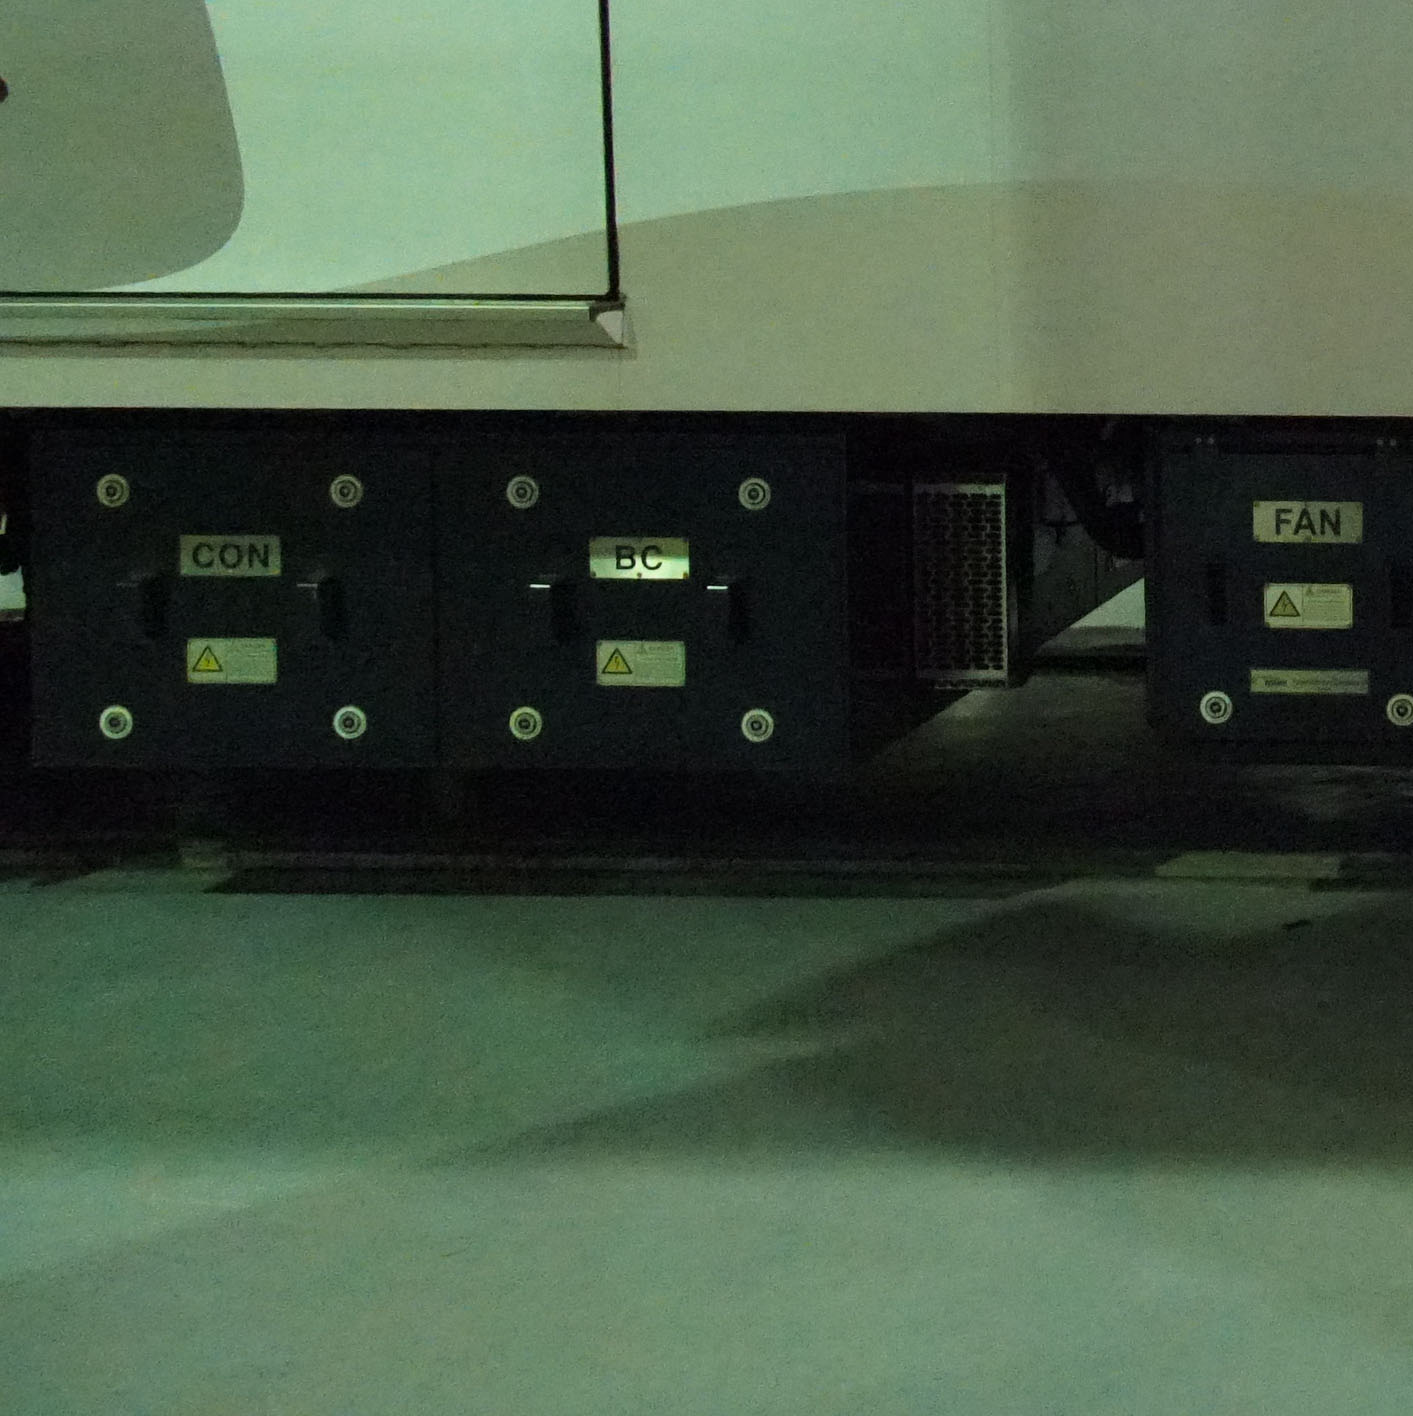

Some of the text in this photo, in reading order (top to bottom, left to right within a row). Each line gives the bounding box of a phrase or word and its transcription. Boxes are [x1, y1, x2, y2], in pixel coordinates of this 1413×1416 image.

[1274, 507, 1342, 537] FAN
[191, 541, 270, 569] CON
[613, 544, 664, 572] BC
